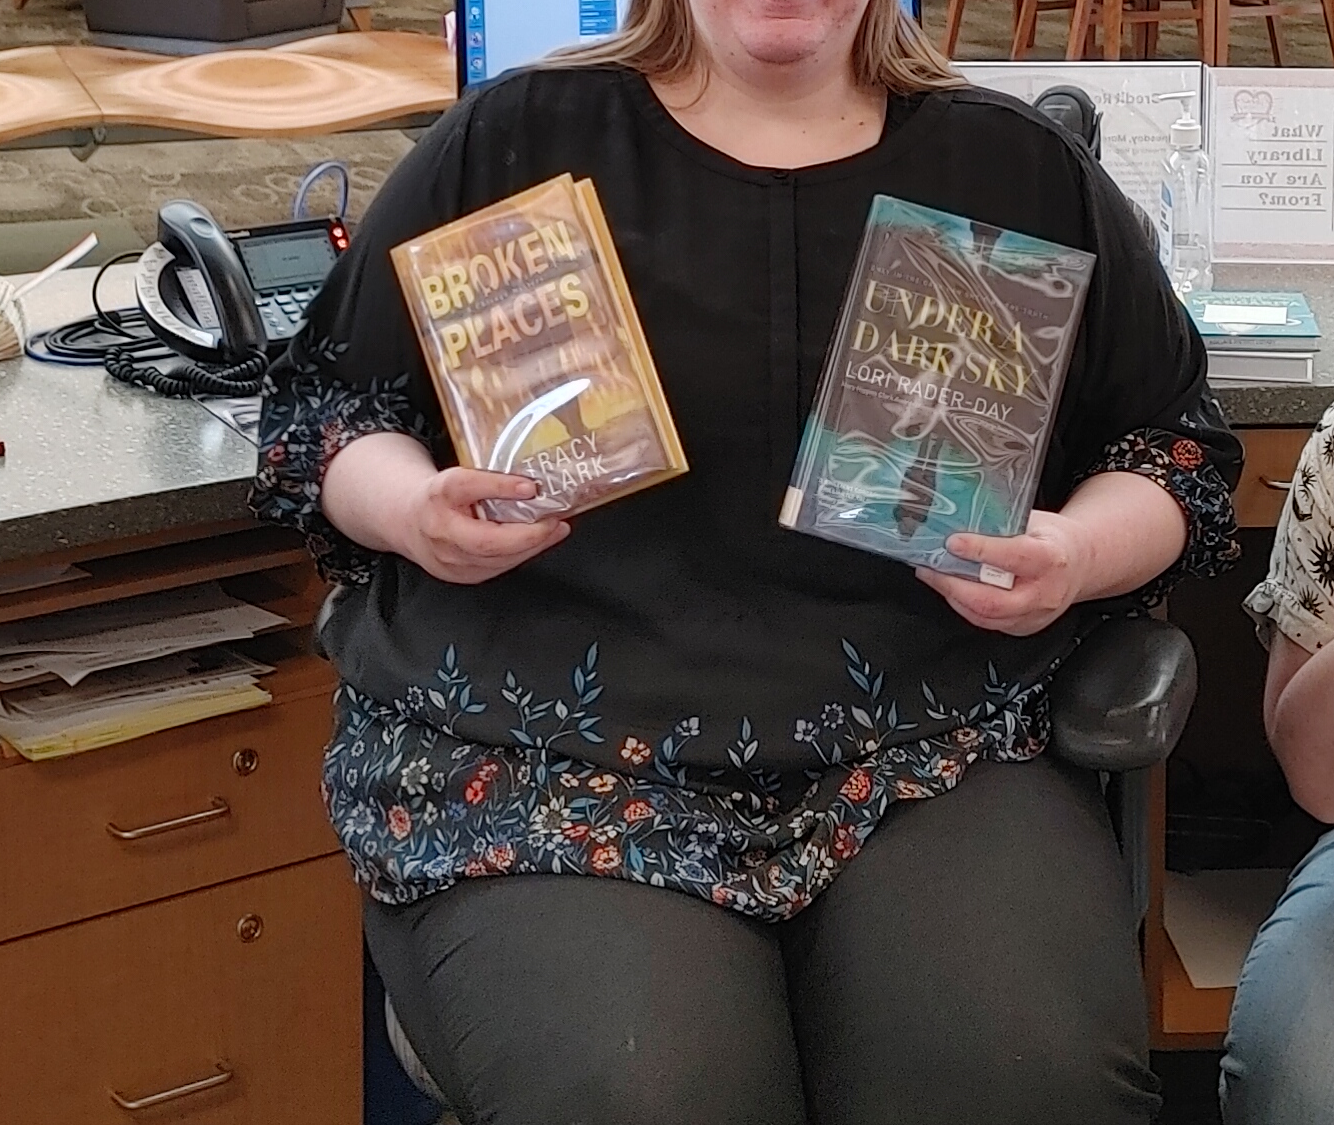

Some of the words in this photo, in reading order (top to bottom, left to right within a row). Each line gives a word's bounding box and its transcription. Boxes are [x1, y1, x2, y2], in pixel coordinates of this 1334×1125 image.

[421, 220, 577, 319] BROKEN
[440, 274, 589, 369] PLACES
[865, 280, 994, 346] UNDER
[998, 321, 1023, 353] A
[846, 361, 891, 388] LORI
[897, 376, 1013, 421] RADER-DAY
[850, 319, 953, 377] DARK
[960, 352, 1038, 396] SKY
[522, 430, 597, 478] TRACY
[534, 454, 609, 501] CLARK
